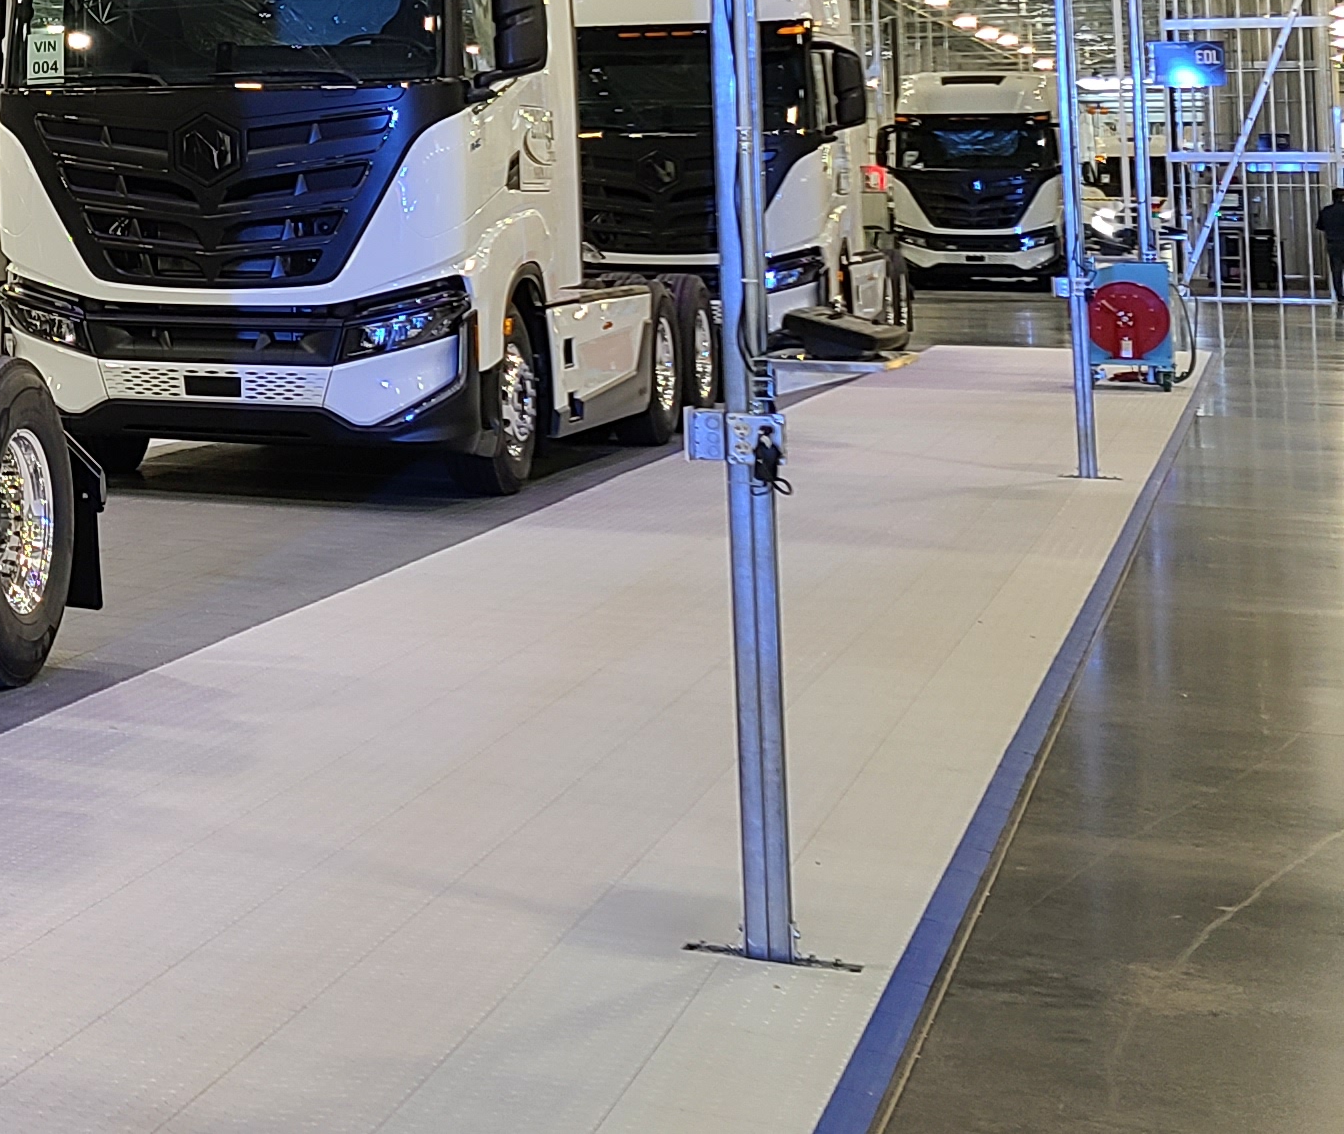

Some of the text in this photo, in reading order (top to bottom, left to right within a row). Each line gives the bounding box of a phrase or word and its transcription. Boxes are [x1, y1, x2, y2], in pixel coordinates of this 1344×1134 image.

[33, 39, 57, 53] VIN
[1194, 49, 1221, 65] EOL
[32, 59, 59, 75] 004
